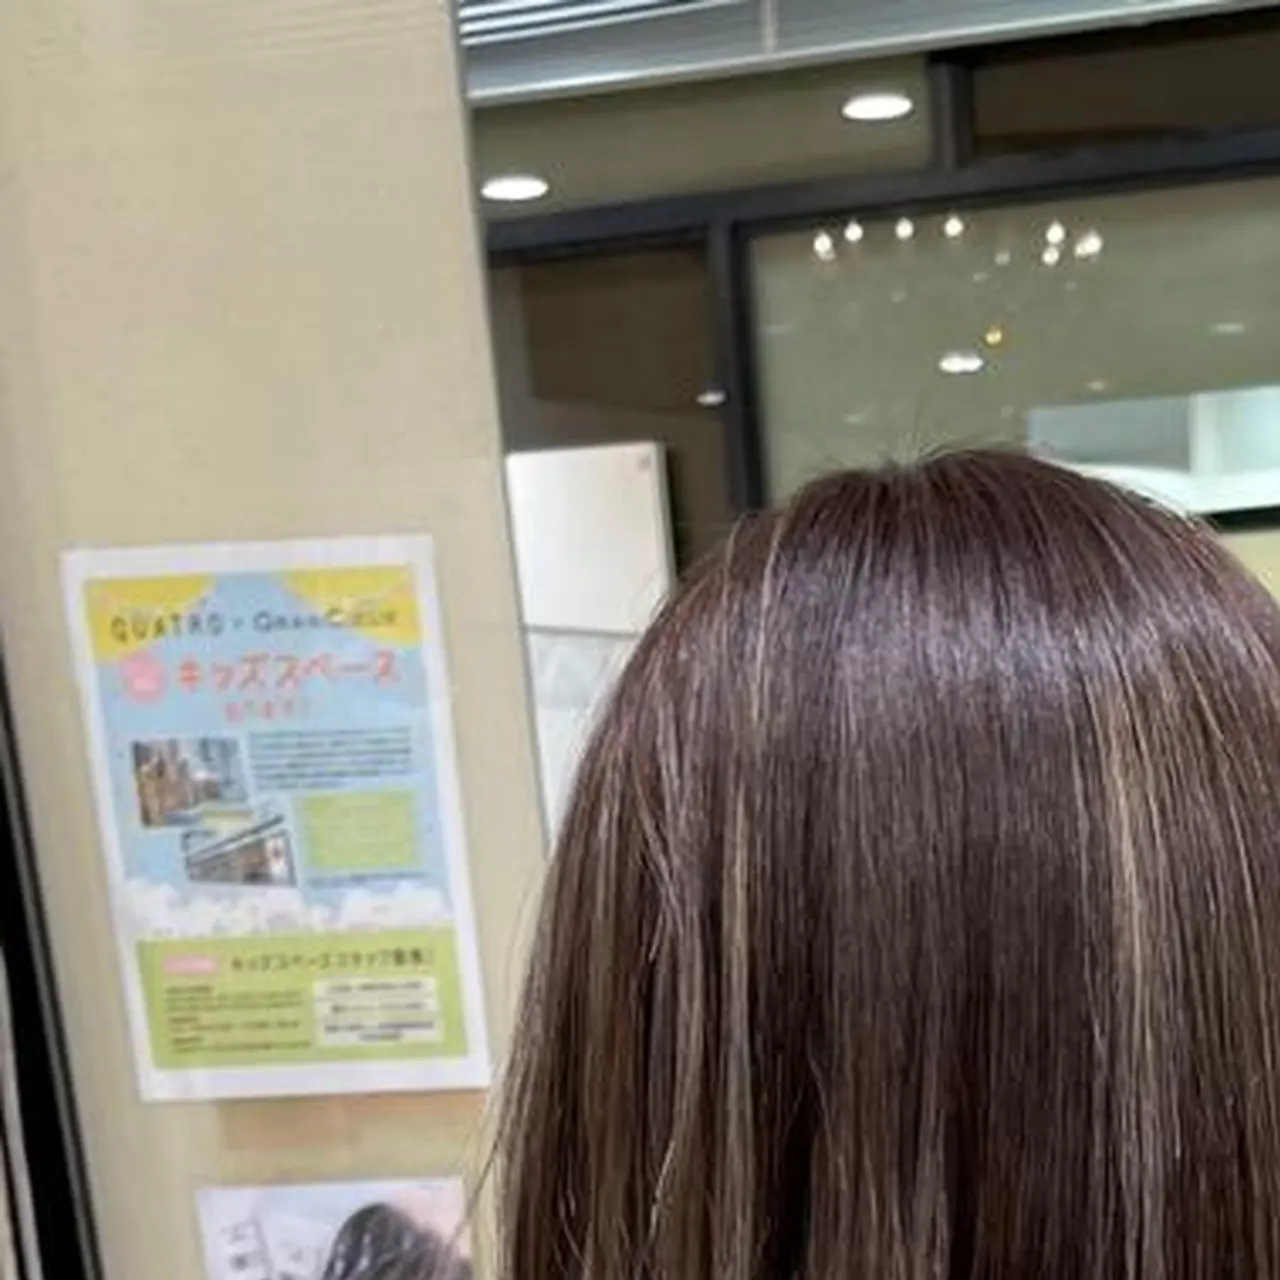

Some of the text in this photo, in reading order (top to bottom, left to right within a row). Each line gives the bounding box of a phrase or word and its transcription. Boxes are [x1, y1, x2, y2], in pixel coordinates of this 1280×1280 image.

[178, 649, 401, 693] キッズスペース
